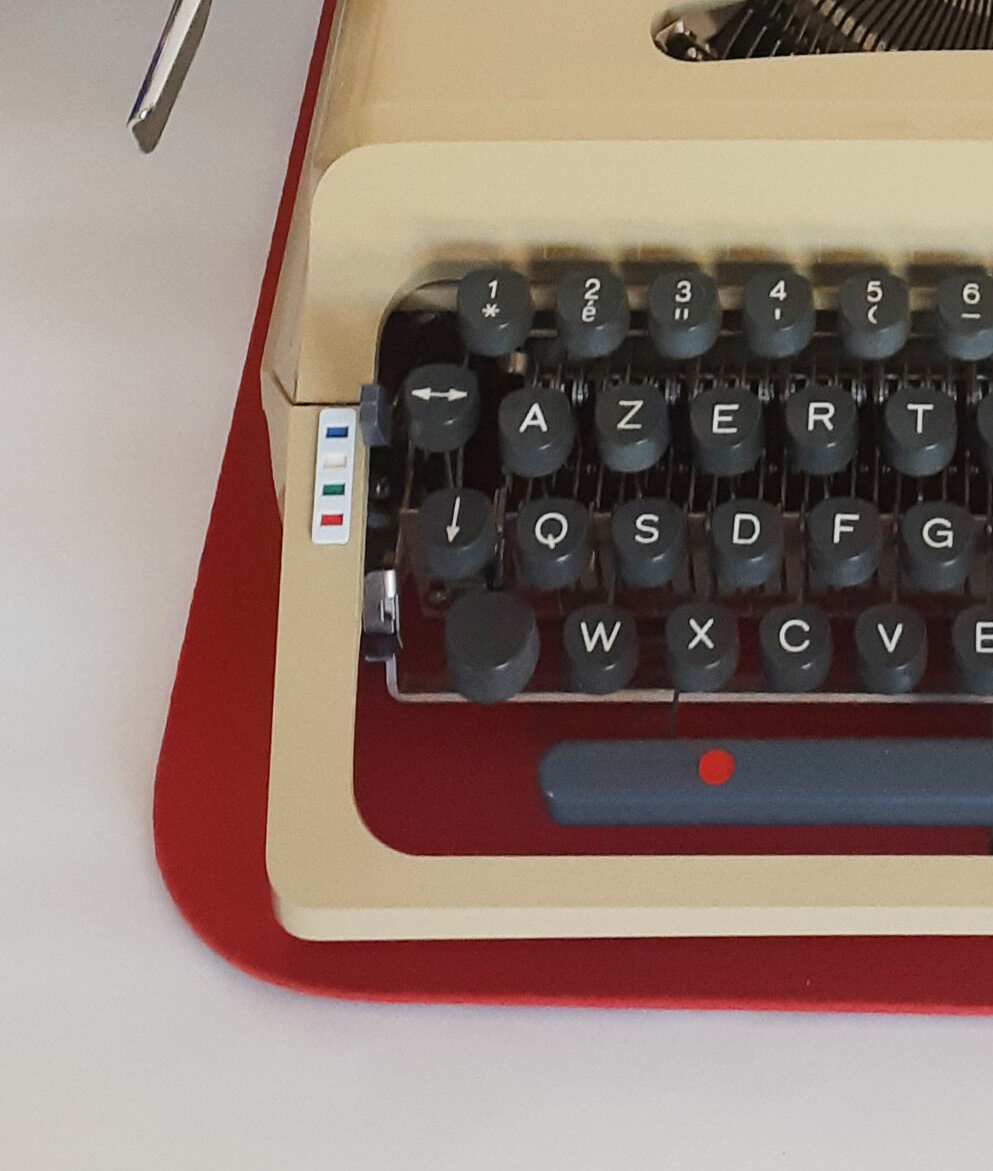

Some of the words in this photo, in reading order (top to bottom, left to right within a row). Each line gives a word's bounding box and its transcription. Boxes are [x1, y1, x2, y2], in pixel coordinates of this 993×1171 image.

[488, 280, 498, 299] 1
[583, 277, 601, 303] 2
[675, 280, 692, 303] 3
[769, 280, 787, 301] 4
[866, 280, 883, 303] 5
[962, 283, 981, 305] 6
[581, 300, 597, 323] é
[867, 305, 878, 324] (
[519, 402, 548, 433] A
[616, 400, 644, 430] Z
[712, 403, 740, 434] E
[807, 402, 835, 431] R
[906, 403, 934, 434] T
[534, 512, 568, 550] Q
[634, 513, 659, 544] S
[732, 513, 761, 545] D
[833, 513, 860, 544] F
[922, 517, 954, 549] G
[580, 621, 621, 653] W
[688, 618, 714, 650] X
[779, 619, 810, 653] C
[877, 623, 903, 653] V
